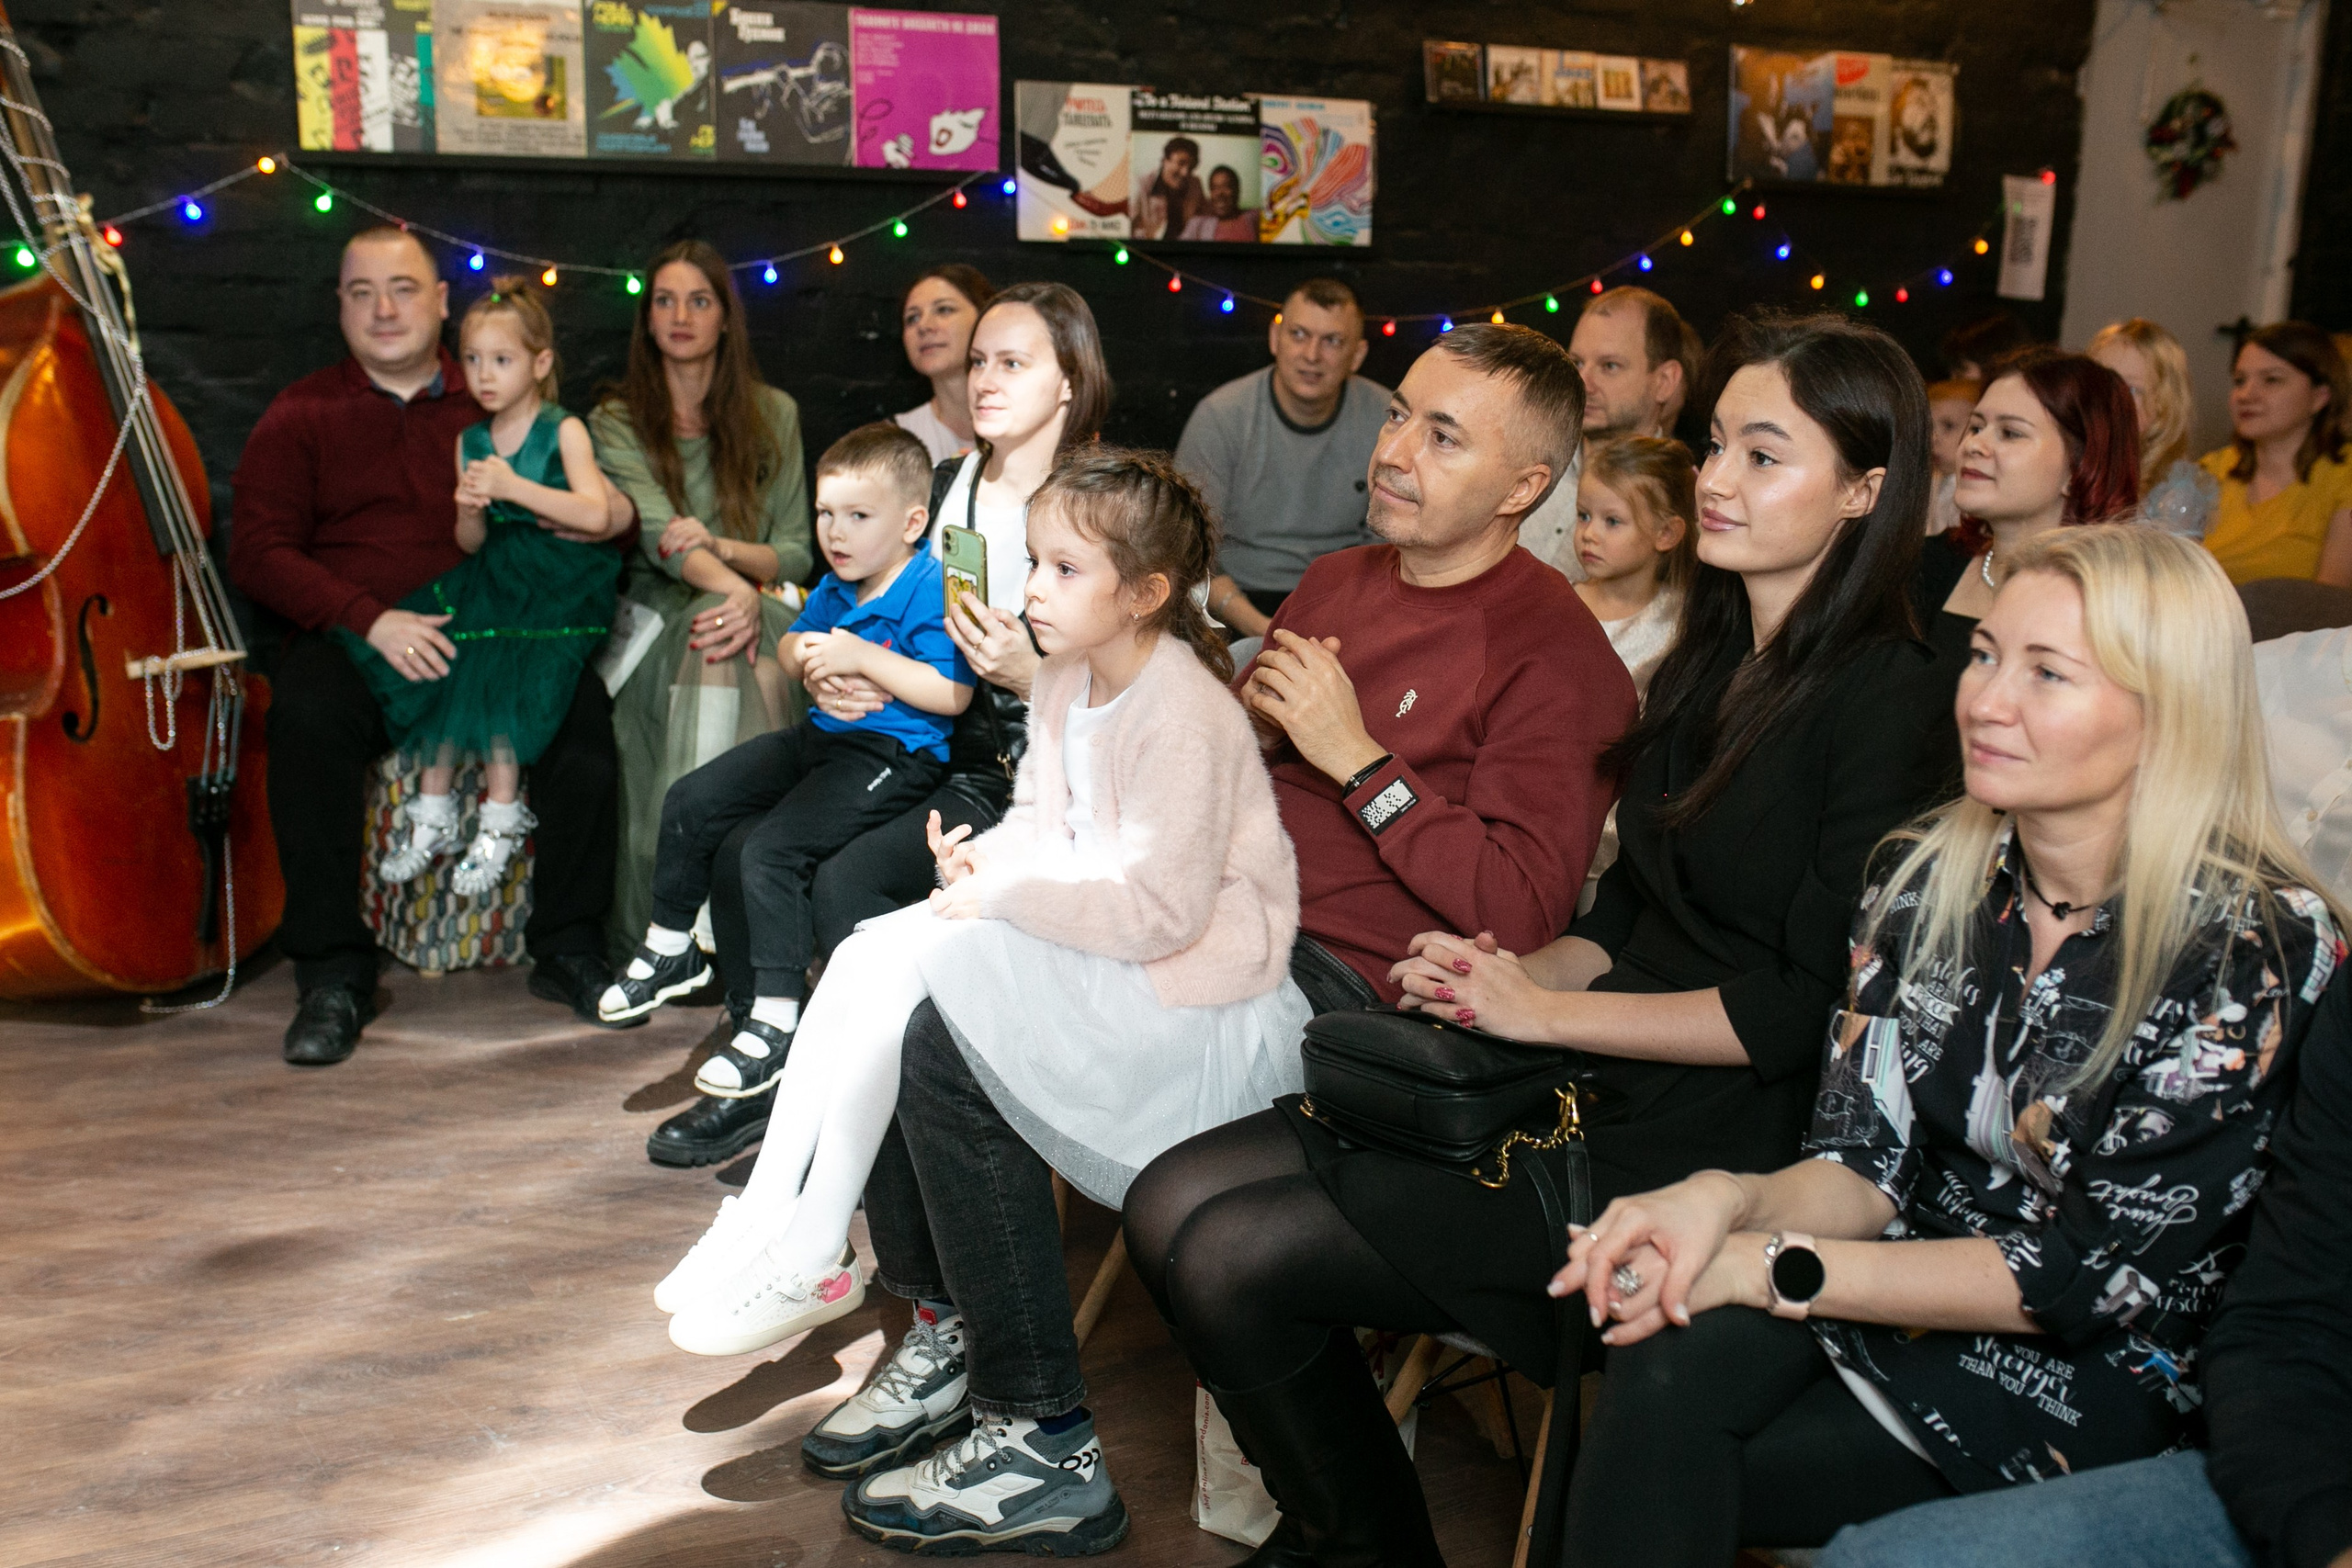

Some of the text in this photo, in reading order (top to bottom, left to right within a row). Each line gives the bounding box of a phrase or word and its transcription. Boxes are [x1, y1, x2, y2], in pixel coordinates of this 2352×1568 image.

[1917, 1039, 1944, 1062] ARE
[2087, 1173, 2199, 1213] Bright
[2106, 1203, 2197, 1256] Shine
[1973, 1336, 2076, 1404] stronger
[2014, 1344, 2075, 1381] YOU ARE
[1958, 1353, 2083, 1427] THAN YOU THINK
